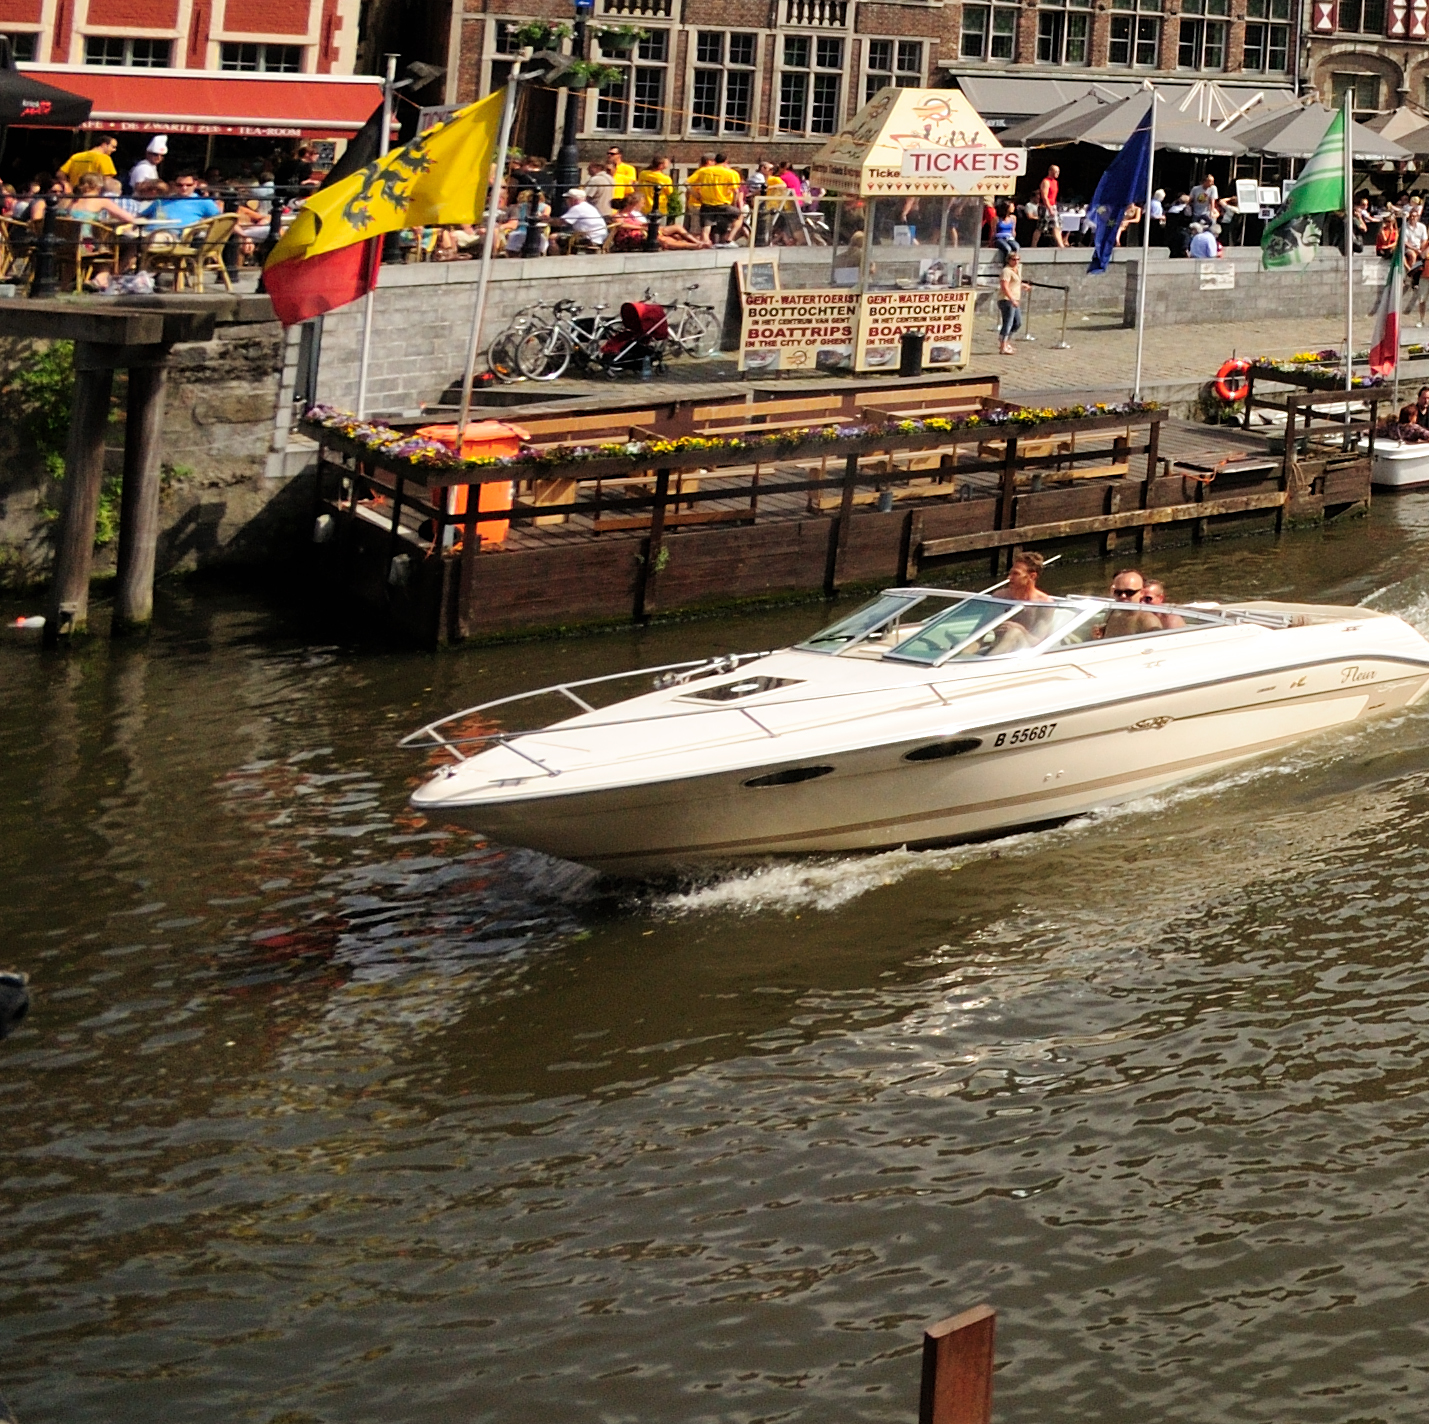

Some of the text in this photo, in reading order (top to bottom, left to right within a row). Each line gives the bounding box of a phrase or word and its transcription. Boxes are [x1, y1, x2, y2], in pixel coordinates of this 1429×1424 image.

[910, 152, 1020, 172] TICKETS
[746, 296, 775, 305] GENT
[781, 294, 861, 304] WATERTOERIST
[867, 295, 893, 304] GENT
[898, 292, 970, 303] WATERTOERIST
[748, 306, 856, 318] BOOTTOCHTEN
[869, 304, 966, 316] BOOTTOCHTEN
[747, 326, 852, 339] BOATTRIPS
[868, 323, 962, 337] BOATTRIPS
[758, 339, 777, 347] THE
[780, 339, 803, 347] CITY
[805, 338, 818, 346] OF
[820, 337, 853, 345] GHENT
[878, 337, 896, 345] THE
[1340, 665, 1377, 684] Fleur
[994, 722, 1058, 747] B 55687
